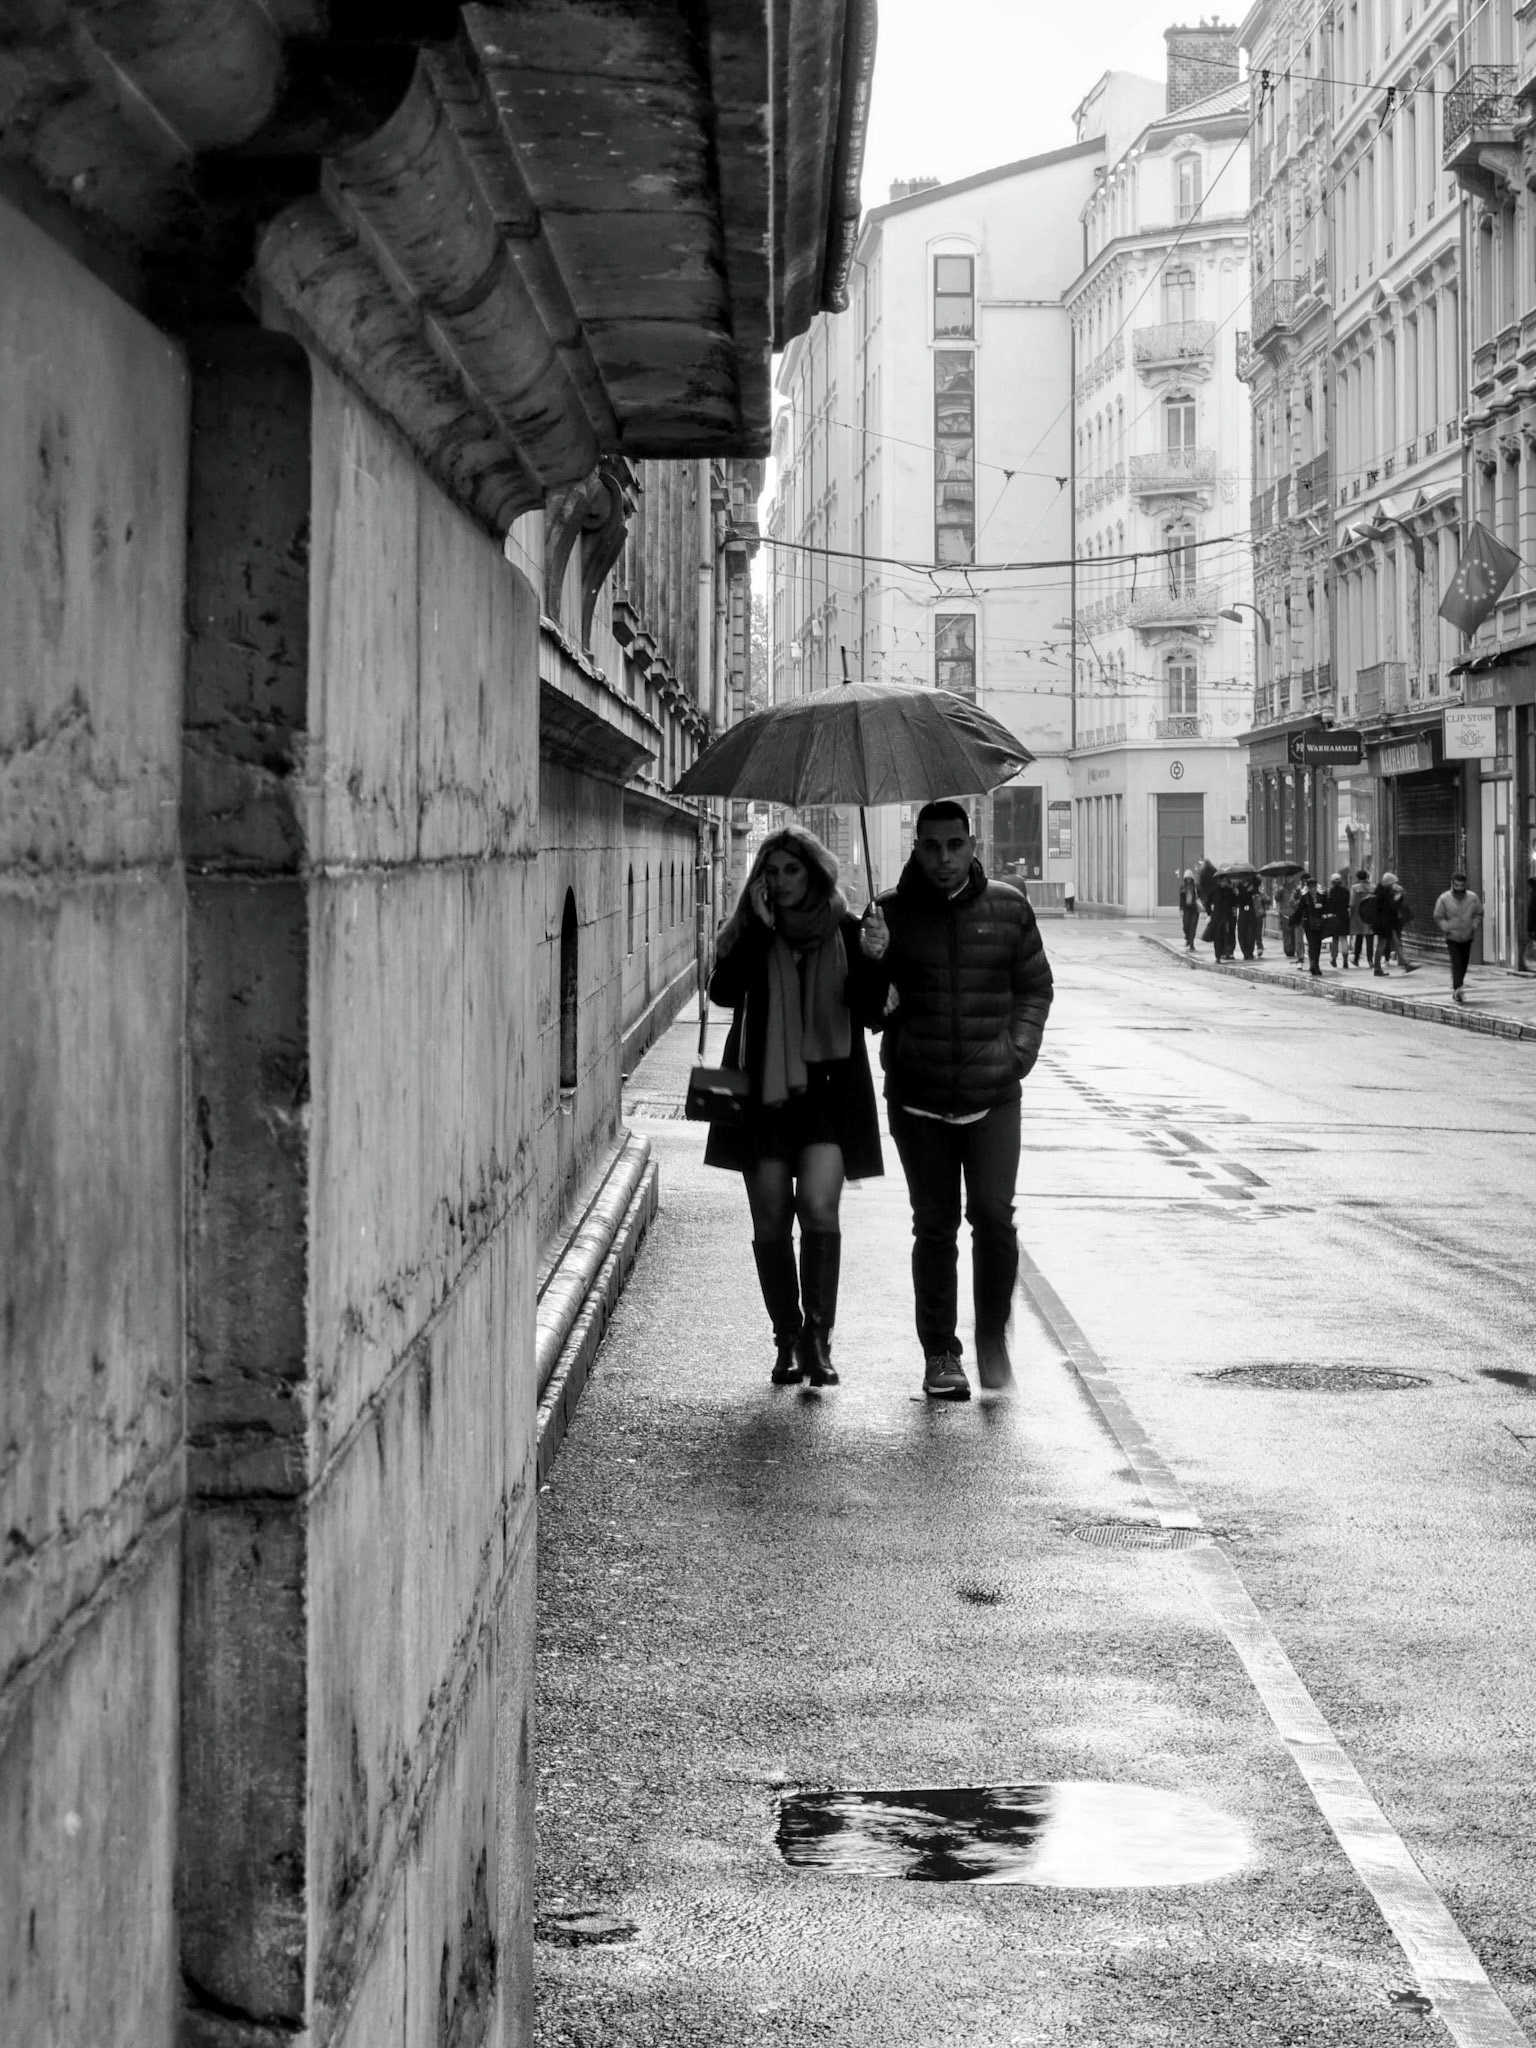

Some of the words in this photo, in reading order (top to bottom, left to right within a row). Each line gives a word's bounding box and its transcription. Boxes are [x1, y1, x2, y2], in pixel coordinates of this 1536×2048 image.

[1446, 714, 1466, 723] CLIP
[1467, 713, 1493, 722] STORY
[1306, 744, 1359, 752] WARHAMMER
